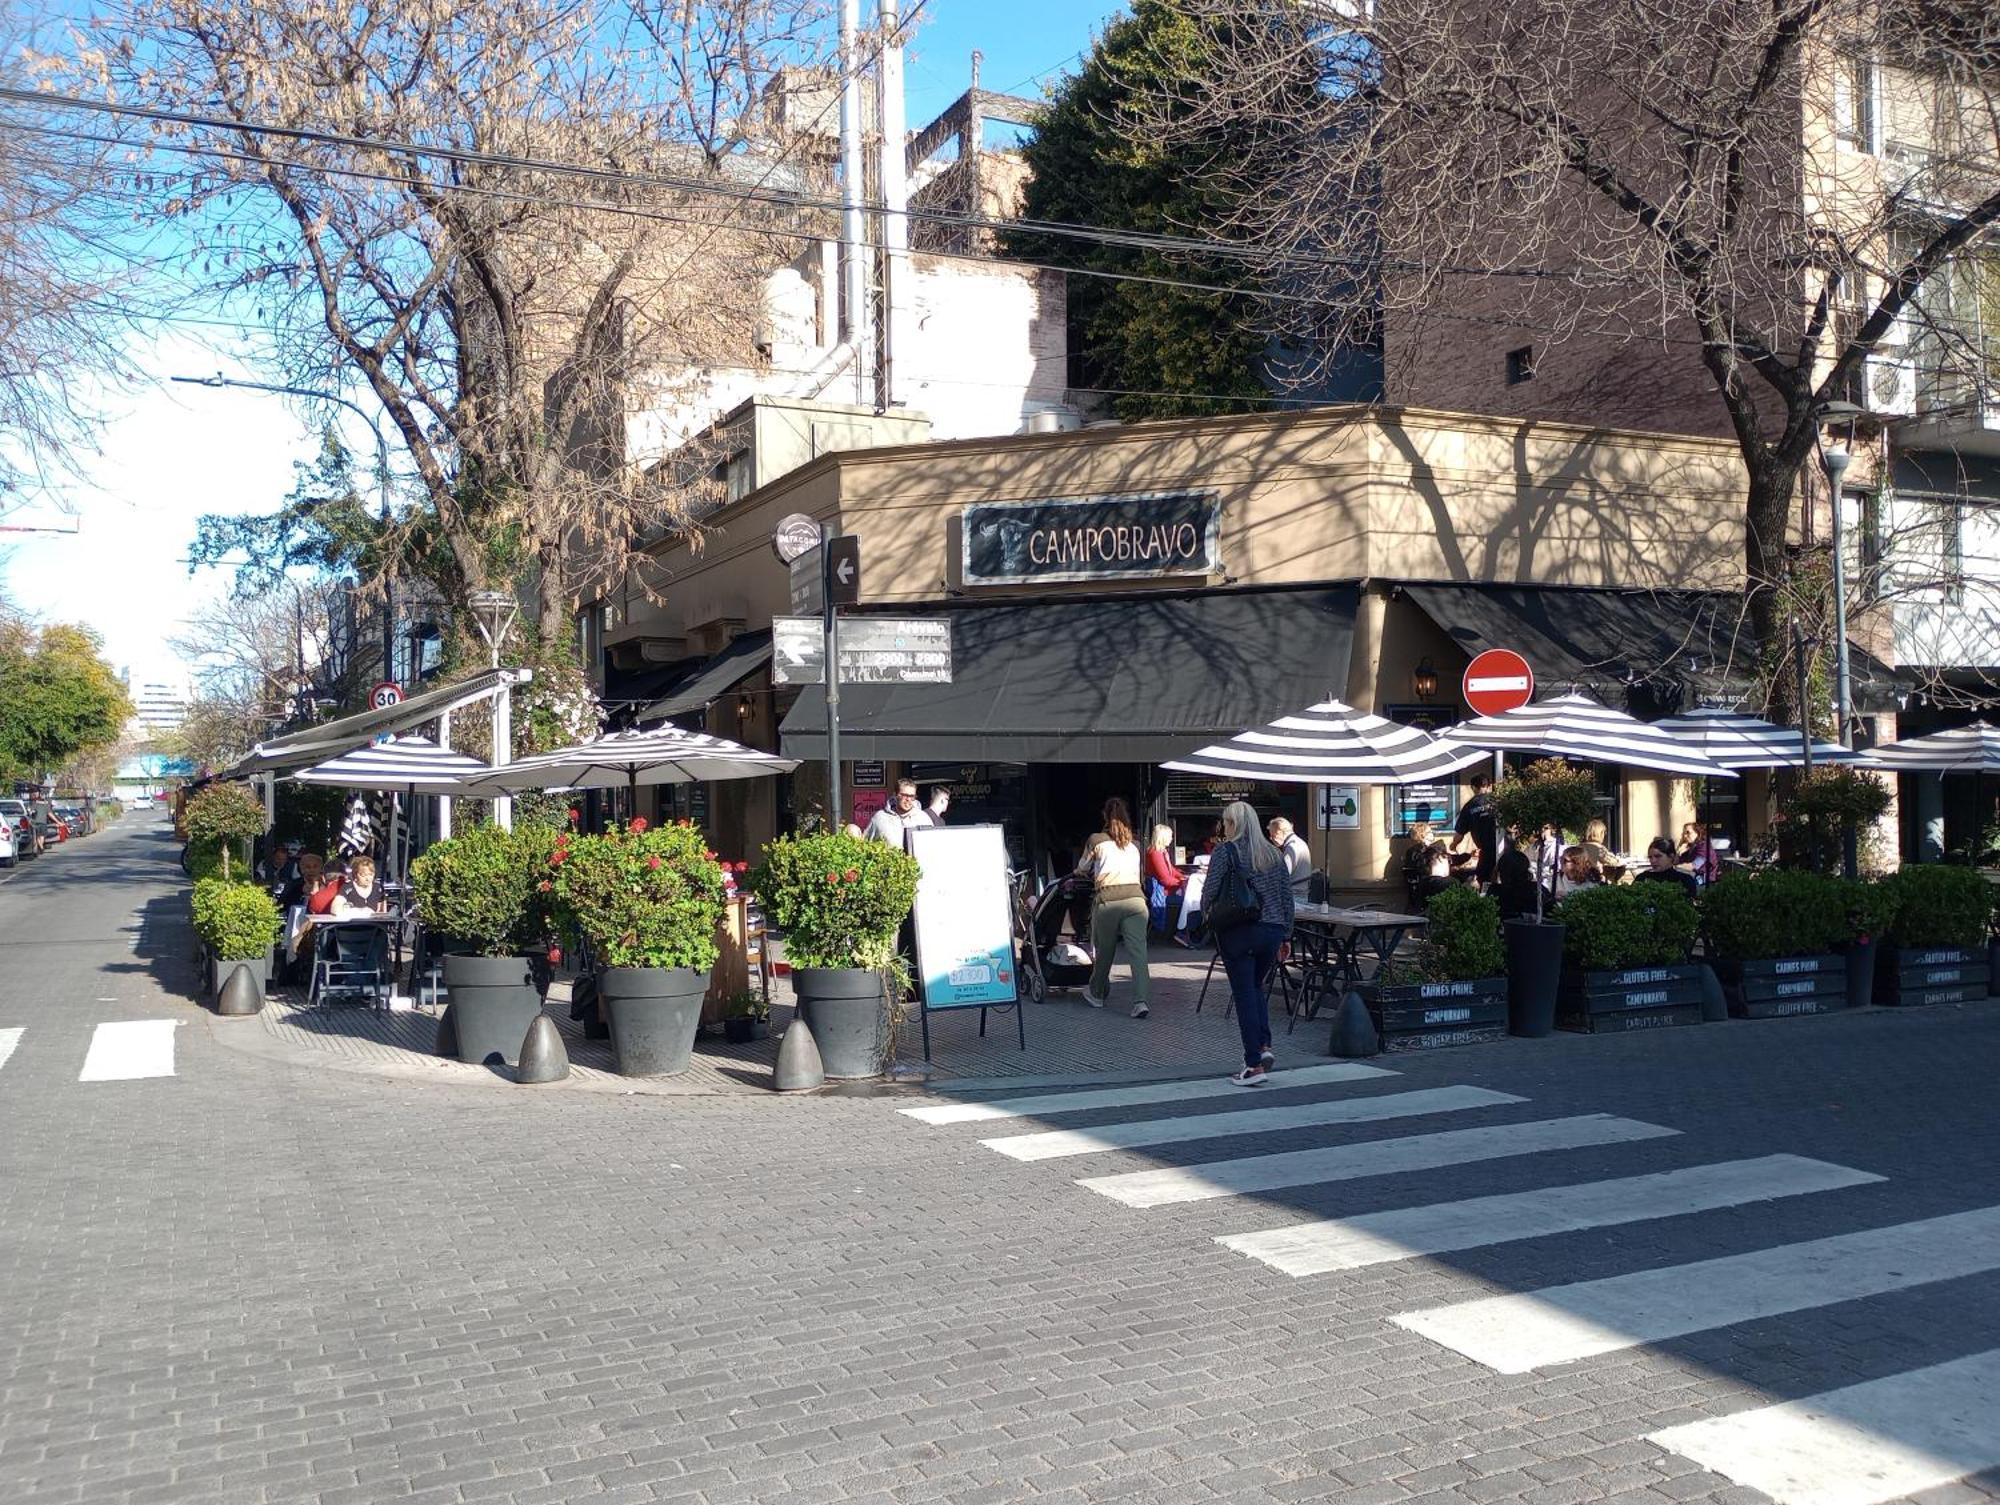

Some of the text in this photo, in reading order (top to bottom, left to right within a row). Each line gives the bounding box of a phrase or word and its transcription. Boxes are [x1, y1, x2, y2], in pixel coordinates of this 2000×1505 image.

[1029, 522, 1197, 564] CAMPOBRAVO
[377, 692, 396, 706] 30
[1623, 969, 1667, 984] GLUTEN FREE
[1421, 983, 1449, 998] CARNES
